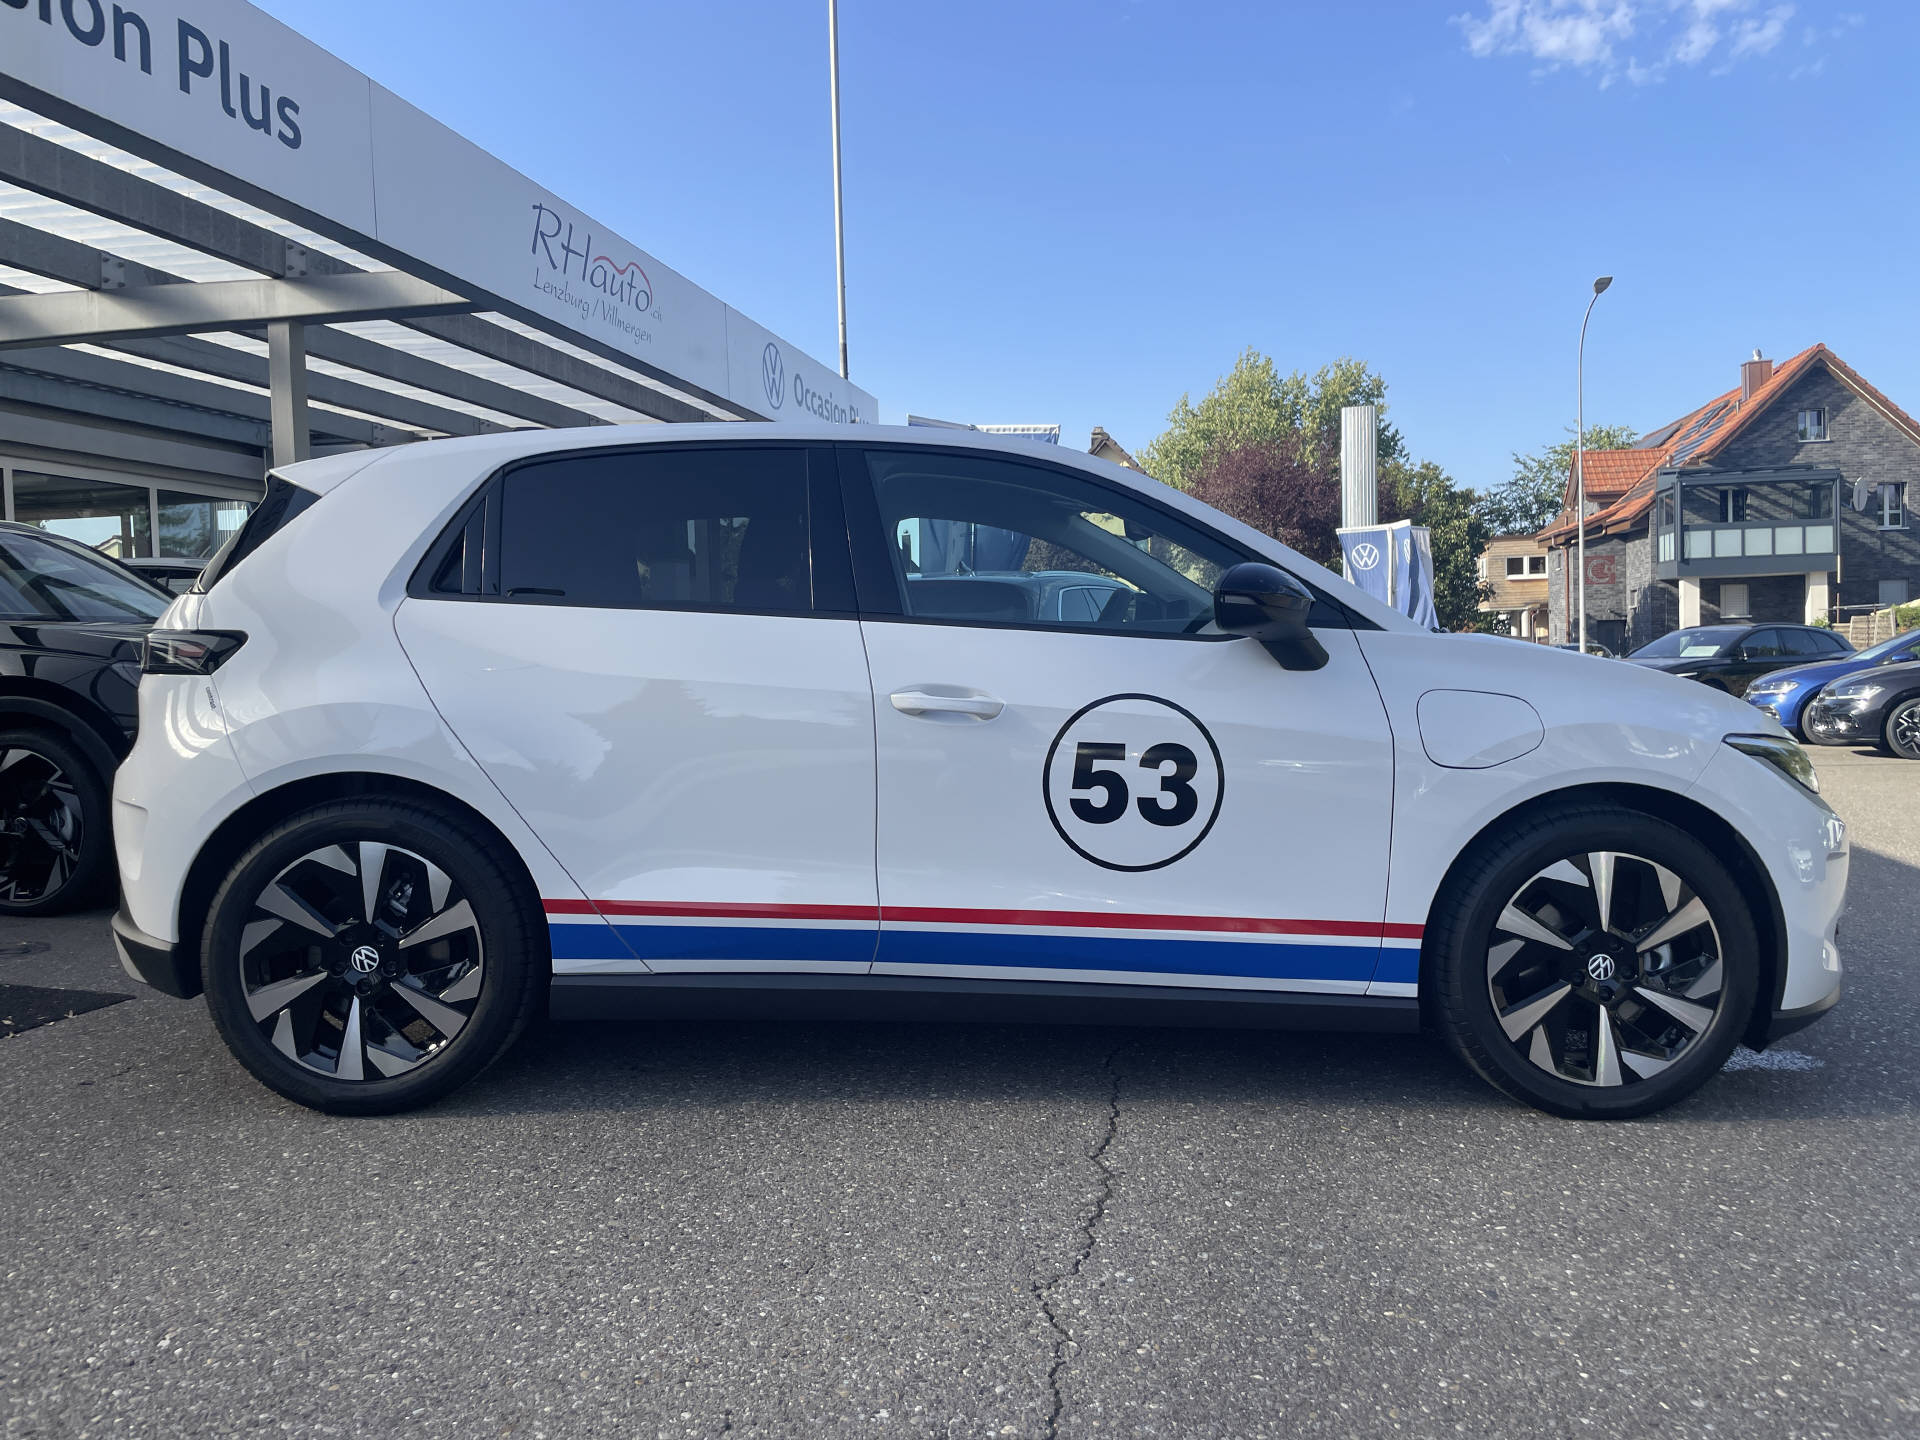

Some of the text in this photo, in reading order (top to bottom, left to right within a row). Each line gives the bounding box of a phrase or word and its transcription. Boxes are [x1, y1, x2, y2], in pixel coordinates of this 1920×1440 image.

[0, 0, 302, 150] on Plus
[533, 266, 590, 320] Lenzburg
[601, 300, 652, 344] Villmergen
[794, 373, 847, 424] Occasion
[1069, 741, 1199, 827] 53
